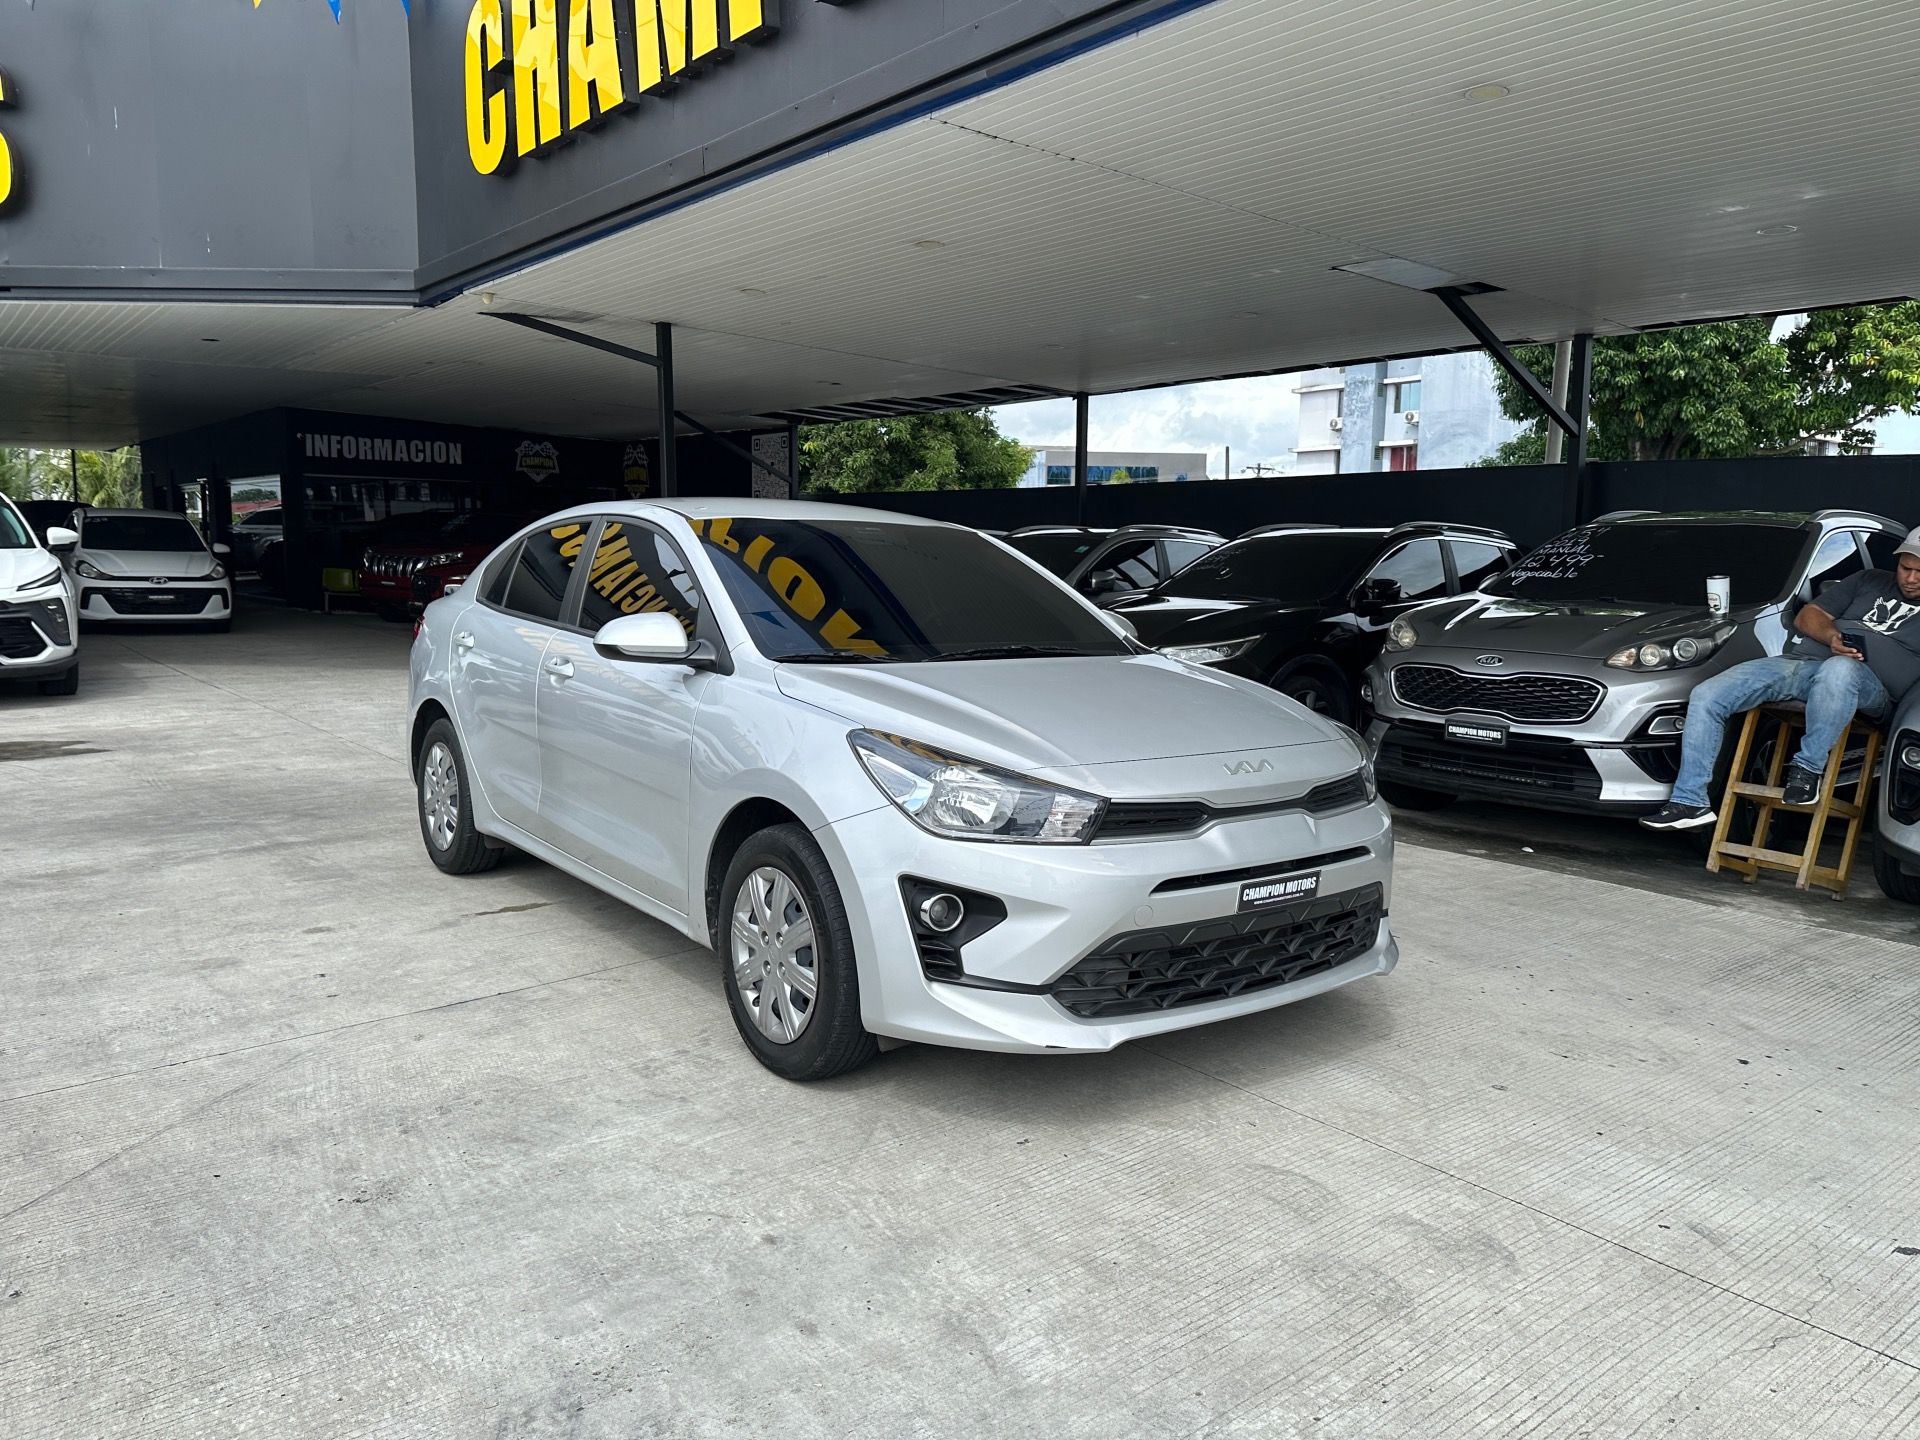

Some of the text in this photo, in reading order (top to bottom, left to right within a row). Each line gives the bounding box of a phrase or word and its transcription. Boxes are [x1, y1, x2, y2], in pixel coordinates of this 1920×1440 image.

[304, 432, 463, 465] INFORMACION
[1478, 656, 1501, 665] KIA
[1448, 726, 1477, 735] CHAMPION
[1478, 729, 1501, 738] MOTORS
[1242, 882, 1285, 901] CHAMPION
[1285, 876, 1317, 894] MOTORS
